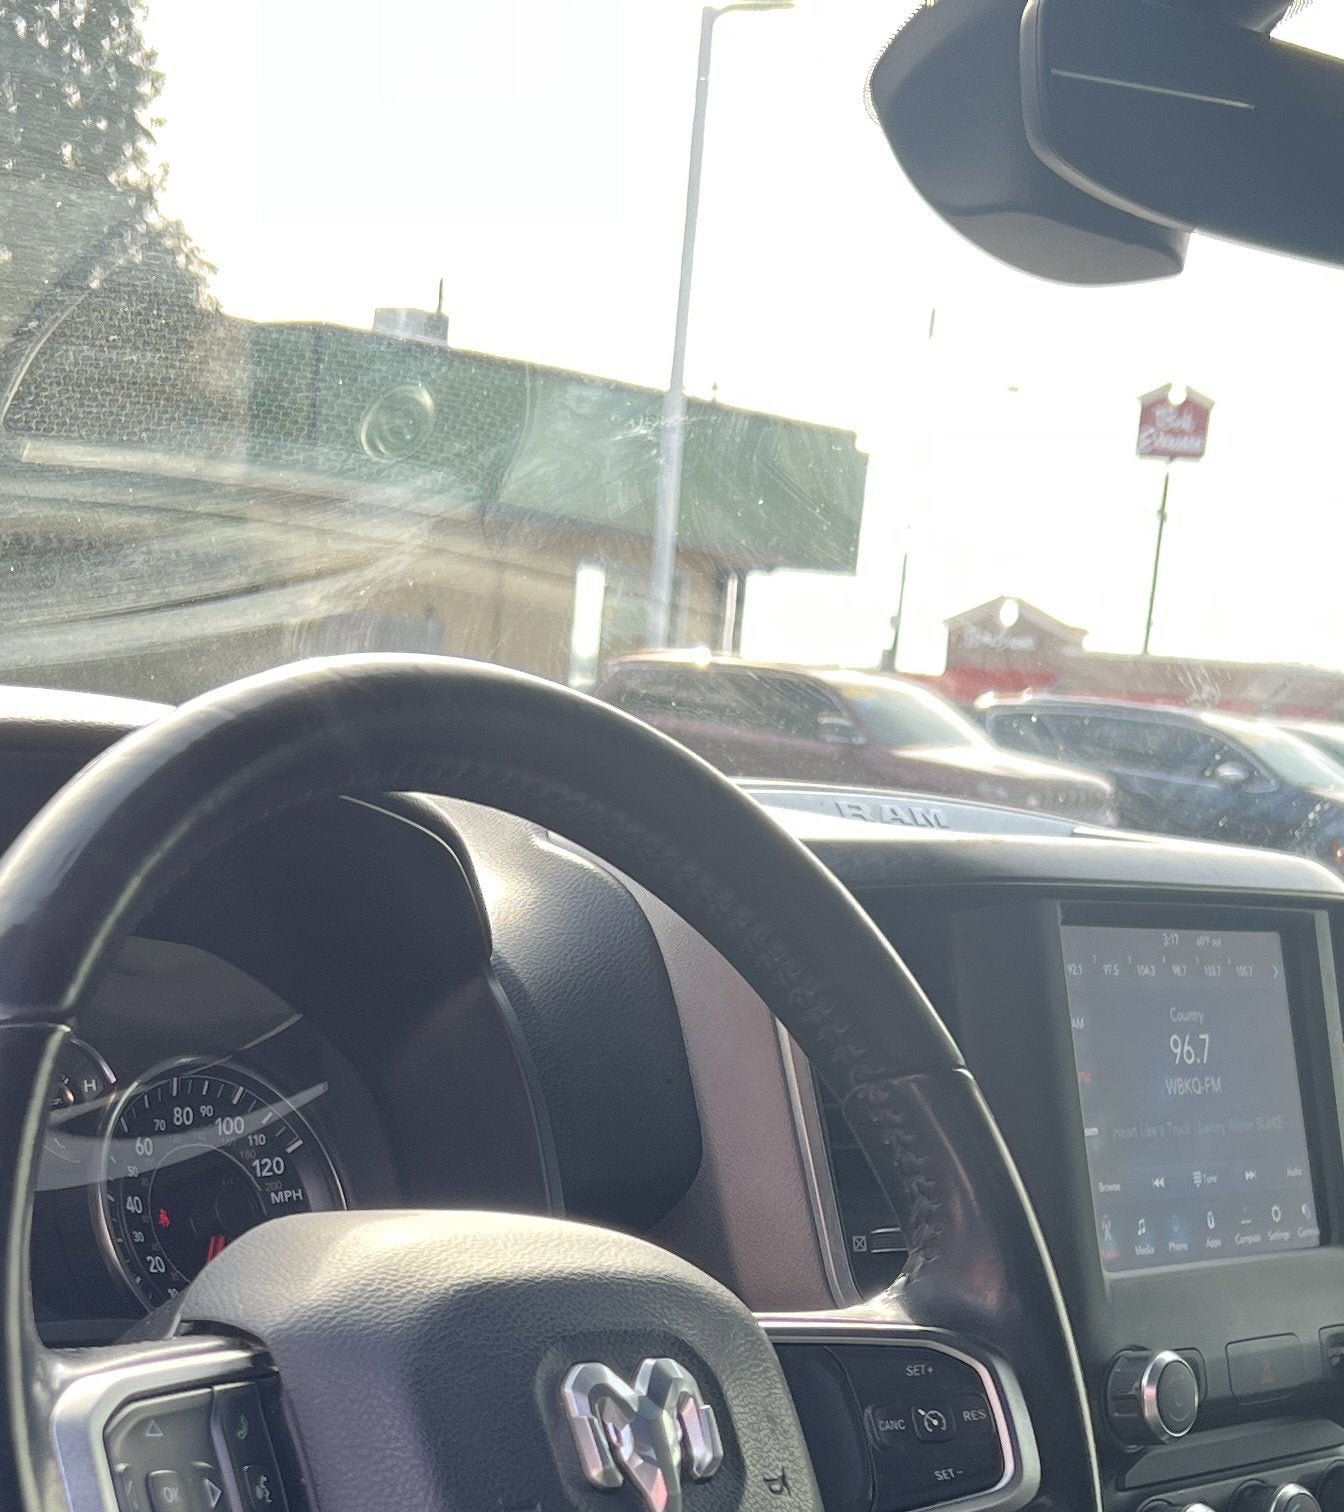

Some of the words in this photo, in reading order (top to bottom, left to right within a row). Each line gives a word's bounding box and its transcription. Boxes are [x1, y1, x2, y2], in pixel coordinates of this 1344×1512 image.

[835, 801, 950, 828] RAM
[1162, 933, 1179, 946] 3:17
[1067, 964, 1083, 976] 92.1
[1170, 1007, 1204, 1024] Country
[1169, 1034, 1210, 1064] 96.7
[84, 1079, 97, 1092] H
[1165, 1077, 1222, 1095] WBKQ-FM
[173, 1106, 194, 1126] 80
[199, 1105, 213, 1118] 90
[153, 1118, 166, 1131] 70
[215, 1116, 244, 1135] 100
[135, 1137, 153, 1156] 60
[247, 1133, 267, 1147] 110
[127, 1165, 139, 1178] 50
[252, 1156, 285, 1178] 120
[266, 1180, 283, 1191] 200
[126, 1196, 143, 1214] 40
[270, 1188, 303, 1205] MPH
[133, 1231, 145, 1243] 30
[146, 1255, 166, 1274] 20
[878, 1419, 905, 1431] CANC
[963, 1409, 987, 1422] RES
[163, 1486, 183, 1503] OK
